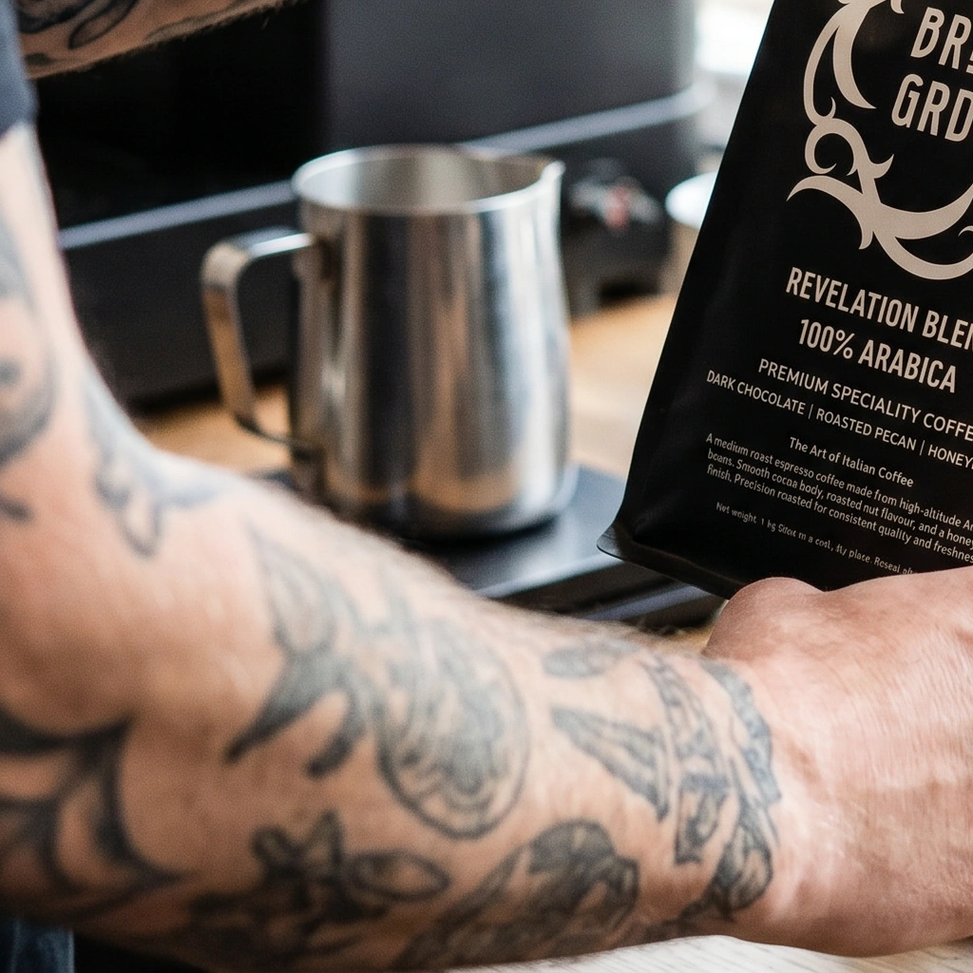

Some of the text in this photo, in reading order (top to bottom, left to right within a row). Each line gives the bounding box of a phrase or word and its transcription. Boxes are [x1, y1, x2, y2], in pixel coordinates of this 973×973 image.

[785, 266, 920, 333] REVELATION
[758, 358, 829, 395] PREMIUM
[831, 383, 922, 424] SPECIALITY
[798, 319, 957, 394] 100% ARABICA
[706, 369, 736, 391] DARK
[736, 381, 806, 415] CHOCOLATE
[816, 407, 873, 437] ROASTED
[874, 426, 917, 452] PECAN
[705, 432, 713, 444] A
[714, 437, 749, 456] medium
[750, 450, 774, 465] roast
[774, 458, 815, 479] espresso
[815, 471, 845, 489] coffee
[846, 481, 873, 499] made
[873, 489, 898, 507] from
[899, 497, 962, 528] high-altitude
[736, 459, 771, 479] Smooth
[800, 479, 825, 500] body,
[826, 491, 862, 511] roasted
[863, 504, 879, 516] nut
[880, 508, 916, 530] flavour,
[918, 521, 937, 535] and
[938, 528, 945, 538] a
[789, 436, 914, 488] The Art of Italian Coffee
[734, 473, 776, 498] Precision
[813, 500, 828, 514] for
[828, 508, 877, 532] consistent
[912, 535, 932, 549] and
